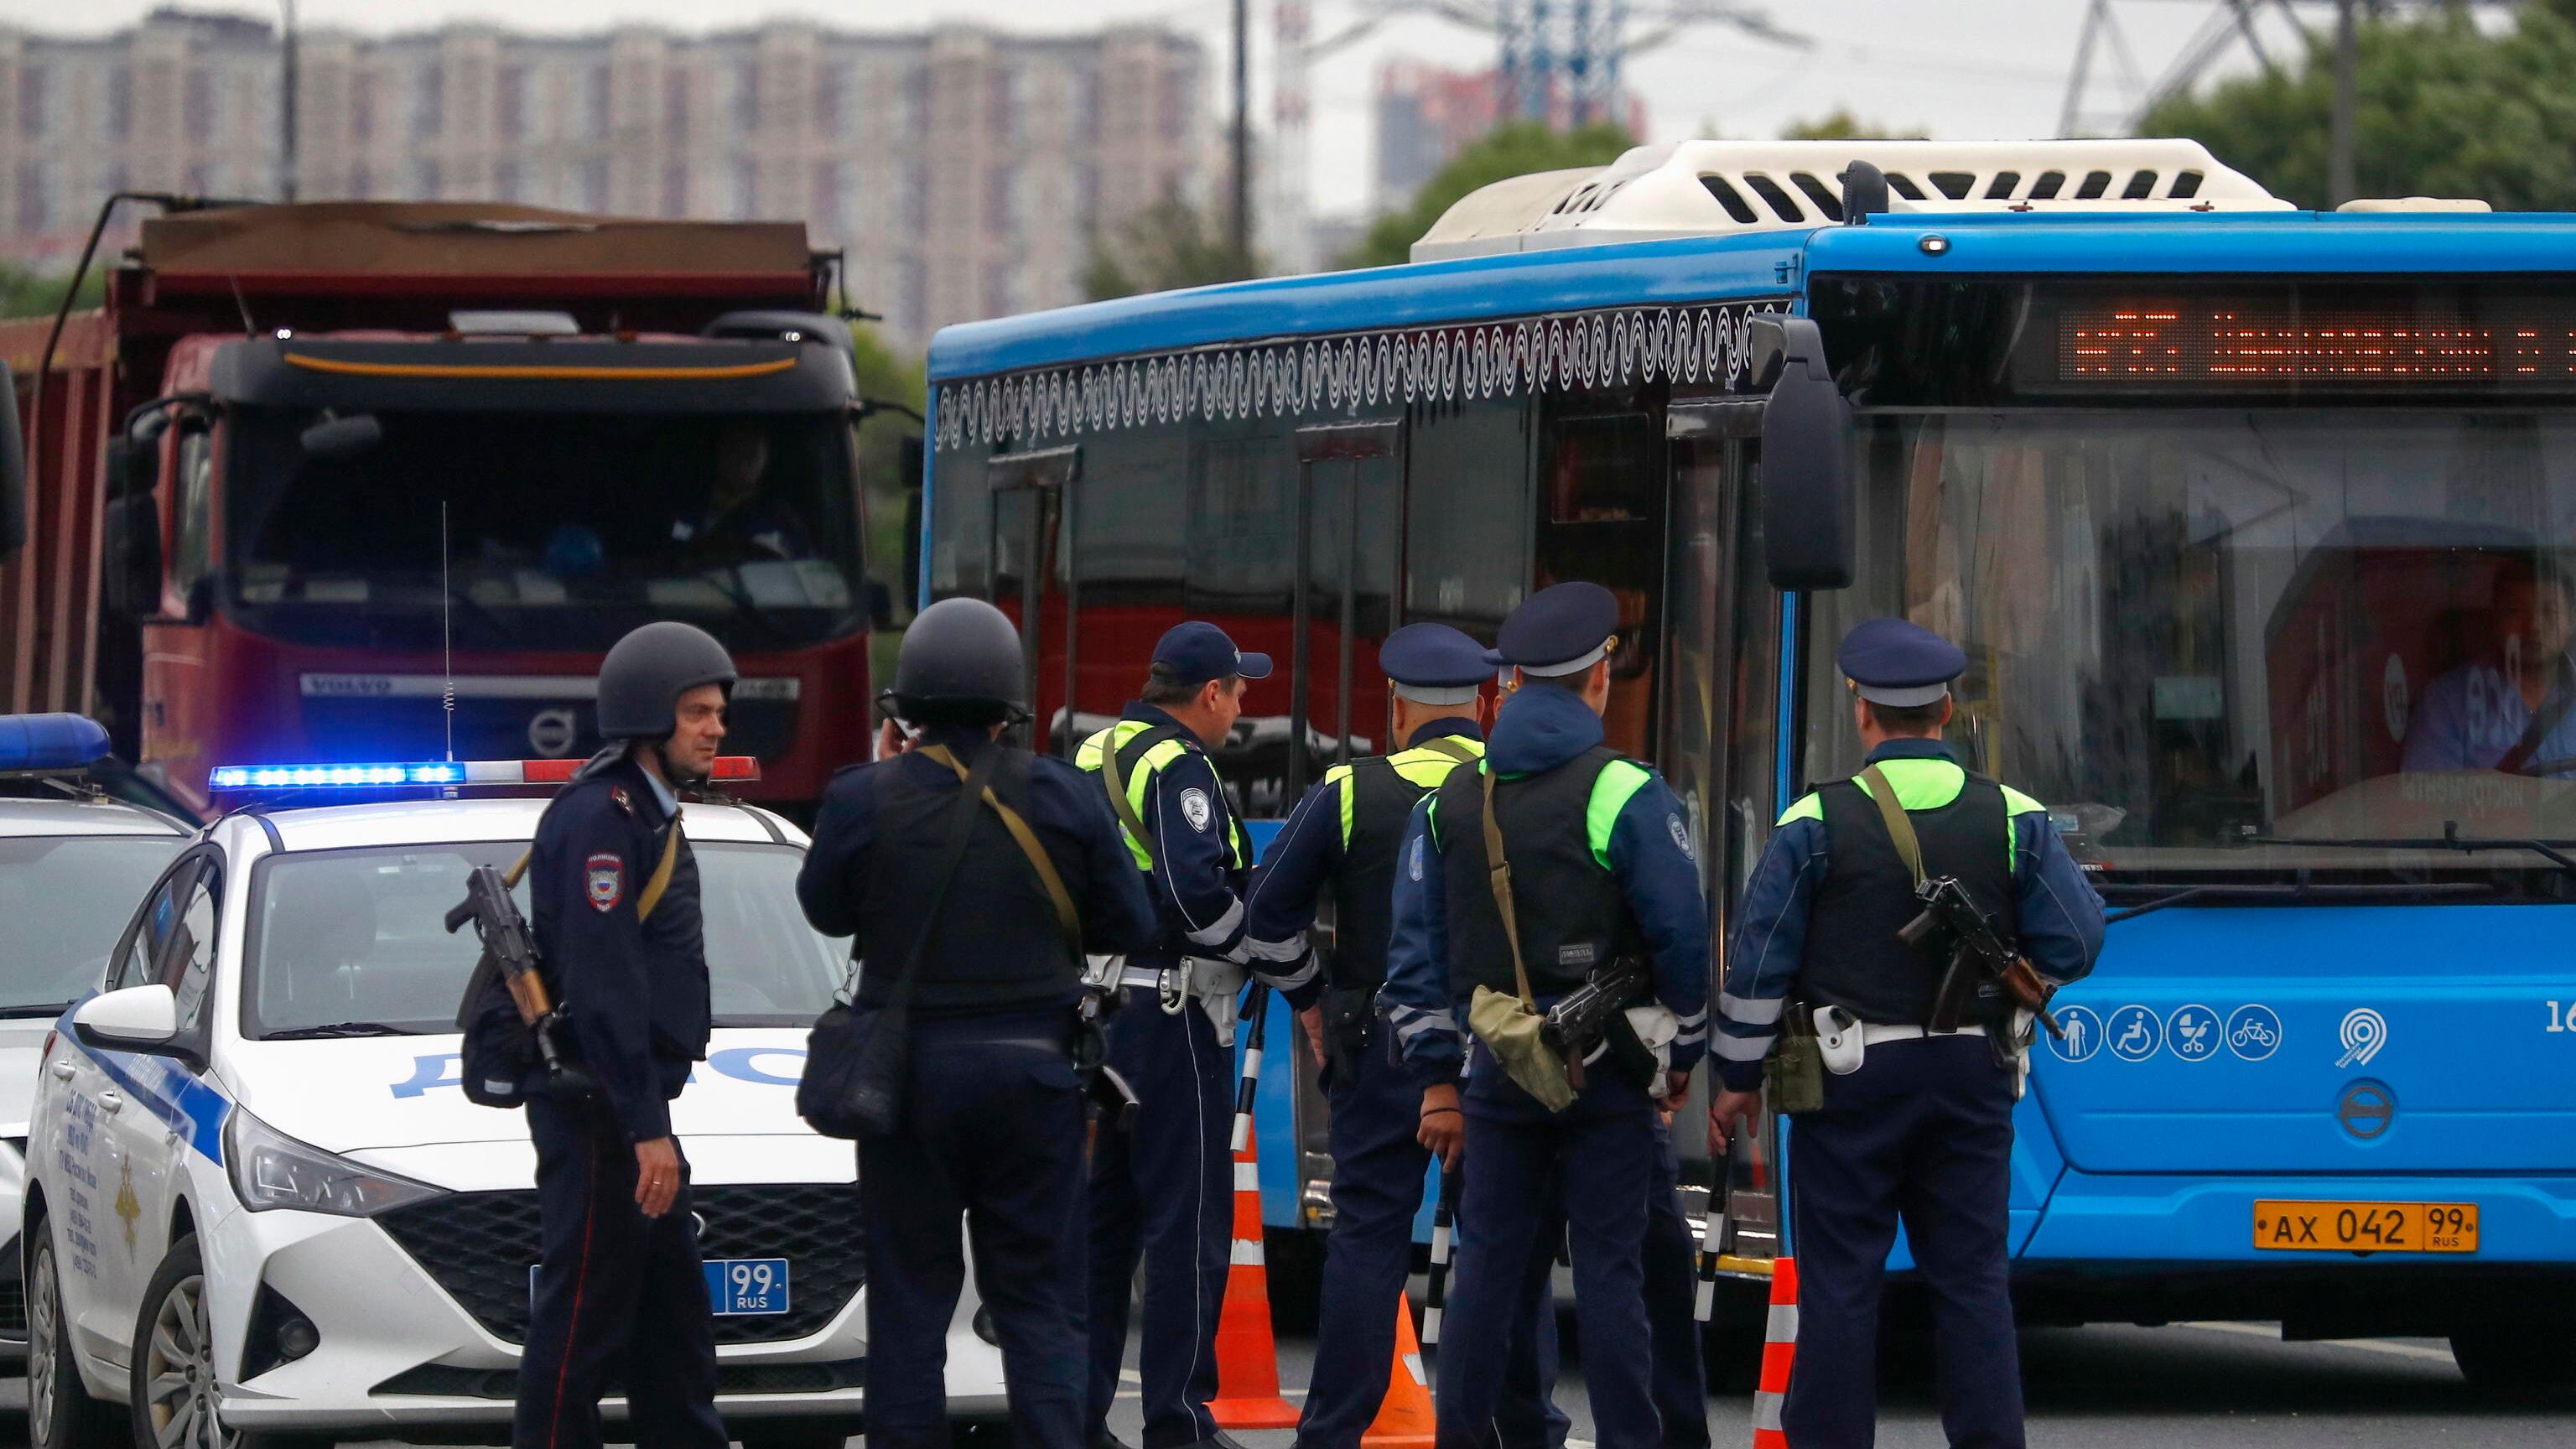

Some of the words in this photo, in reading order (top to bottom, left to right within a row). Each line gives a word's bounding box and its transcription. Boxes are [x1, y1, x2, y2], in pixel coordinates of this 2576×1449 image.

[312, 680, 392, 694] VOLVO
[2337, 1209, 2405, 1244] 042
[2428, 1208, 2464, 1234] 99
[2433, 1237, 2459, 1247] RUS
[731, 1265, 772, 1296] 99
[736, 1297, 767, 1308] RUS
